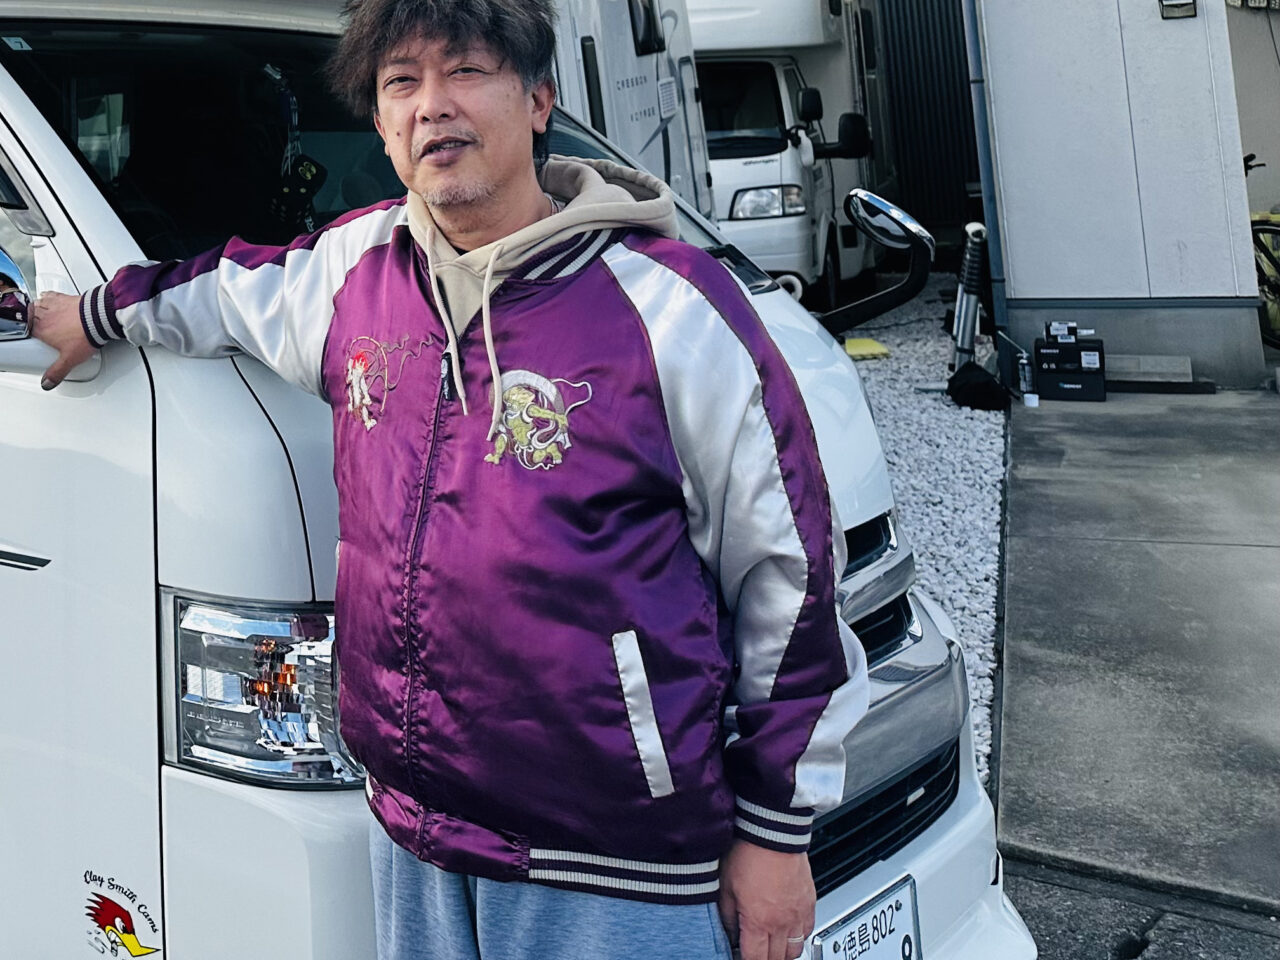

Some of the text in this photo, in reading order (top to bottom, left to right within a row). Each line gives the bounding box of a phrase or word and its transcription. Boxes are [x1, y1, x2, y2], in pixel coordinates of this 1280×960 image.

[83, 869, 159, 933] Clay Smith Cams
